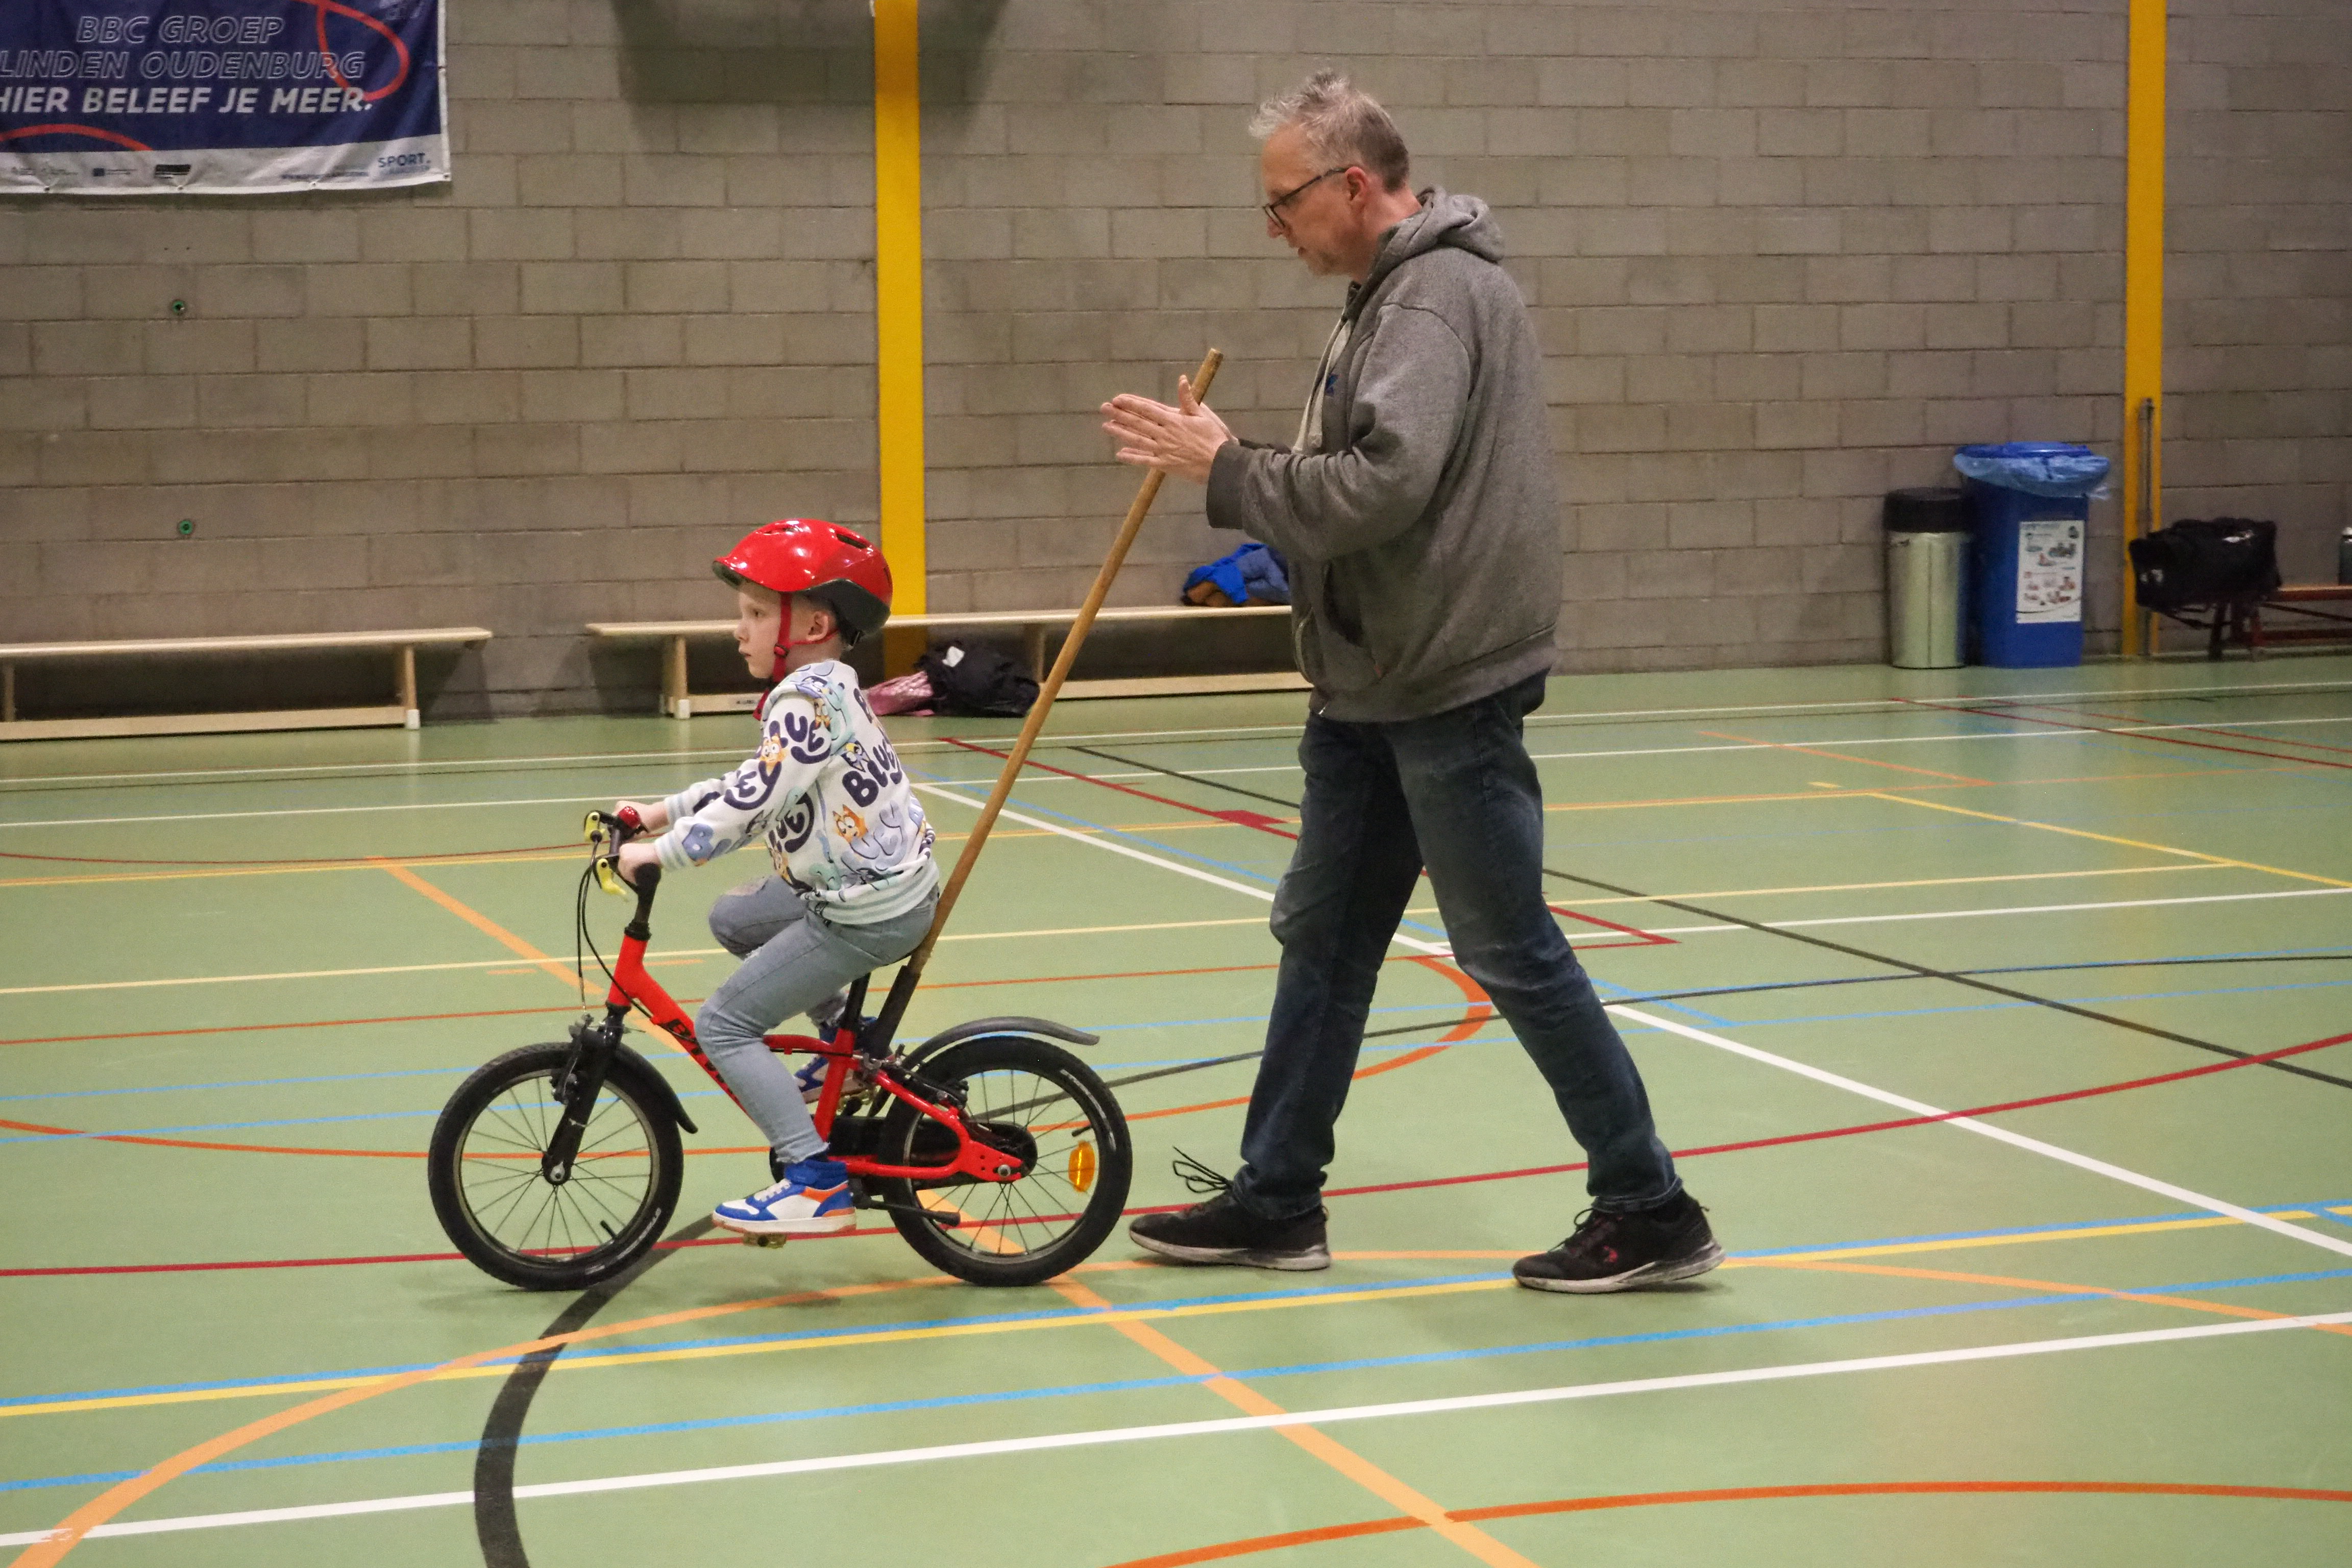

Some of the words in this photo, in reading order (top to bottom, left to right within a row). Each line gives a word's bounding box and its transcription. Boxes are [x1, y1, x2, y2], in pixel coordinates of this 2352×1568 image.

[77, 16, 150, 43] BBC
[159, 15, 285, 44] GROEP
[0, 51, 130, 78] LINDEN
[139, 51, 365, 79] OUDENBURG
[82, 87, 212, 113] BELEEF
[218, 88, 260, 113] JE
[270, 87, 373, 113] MEER.
[378, 152, 431, 167] SPORT.
